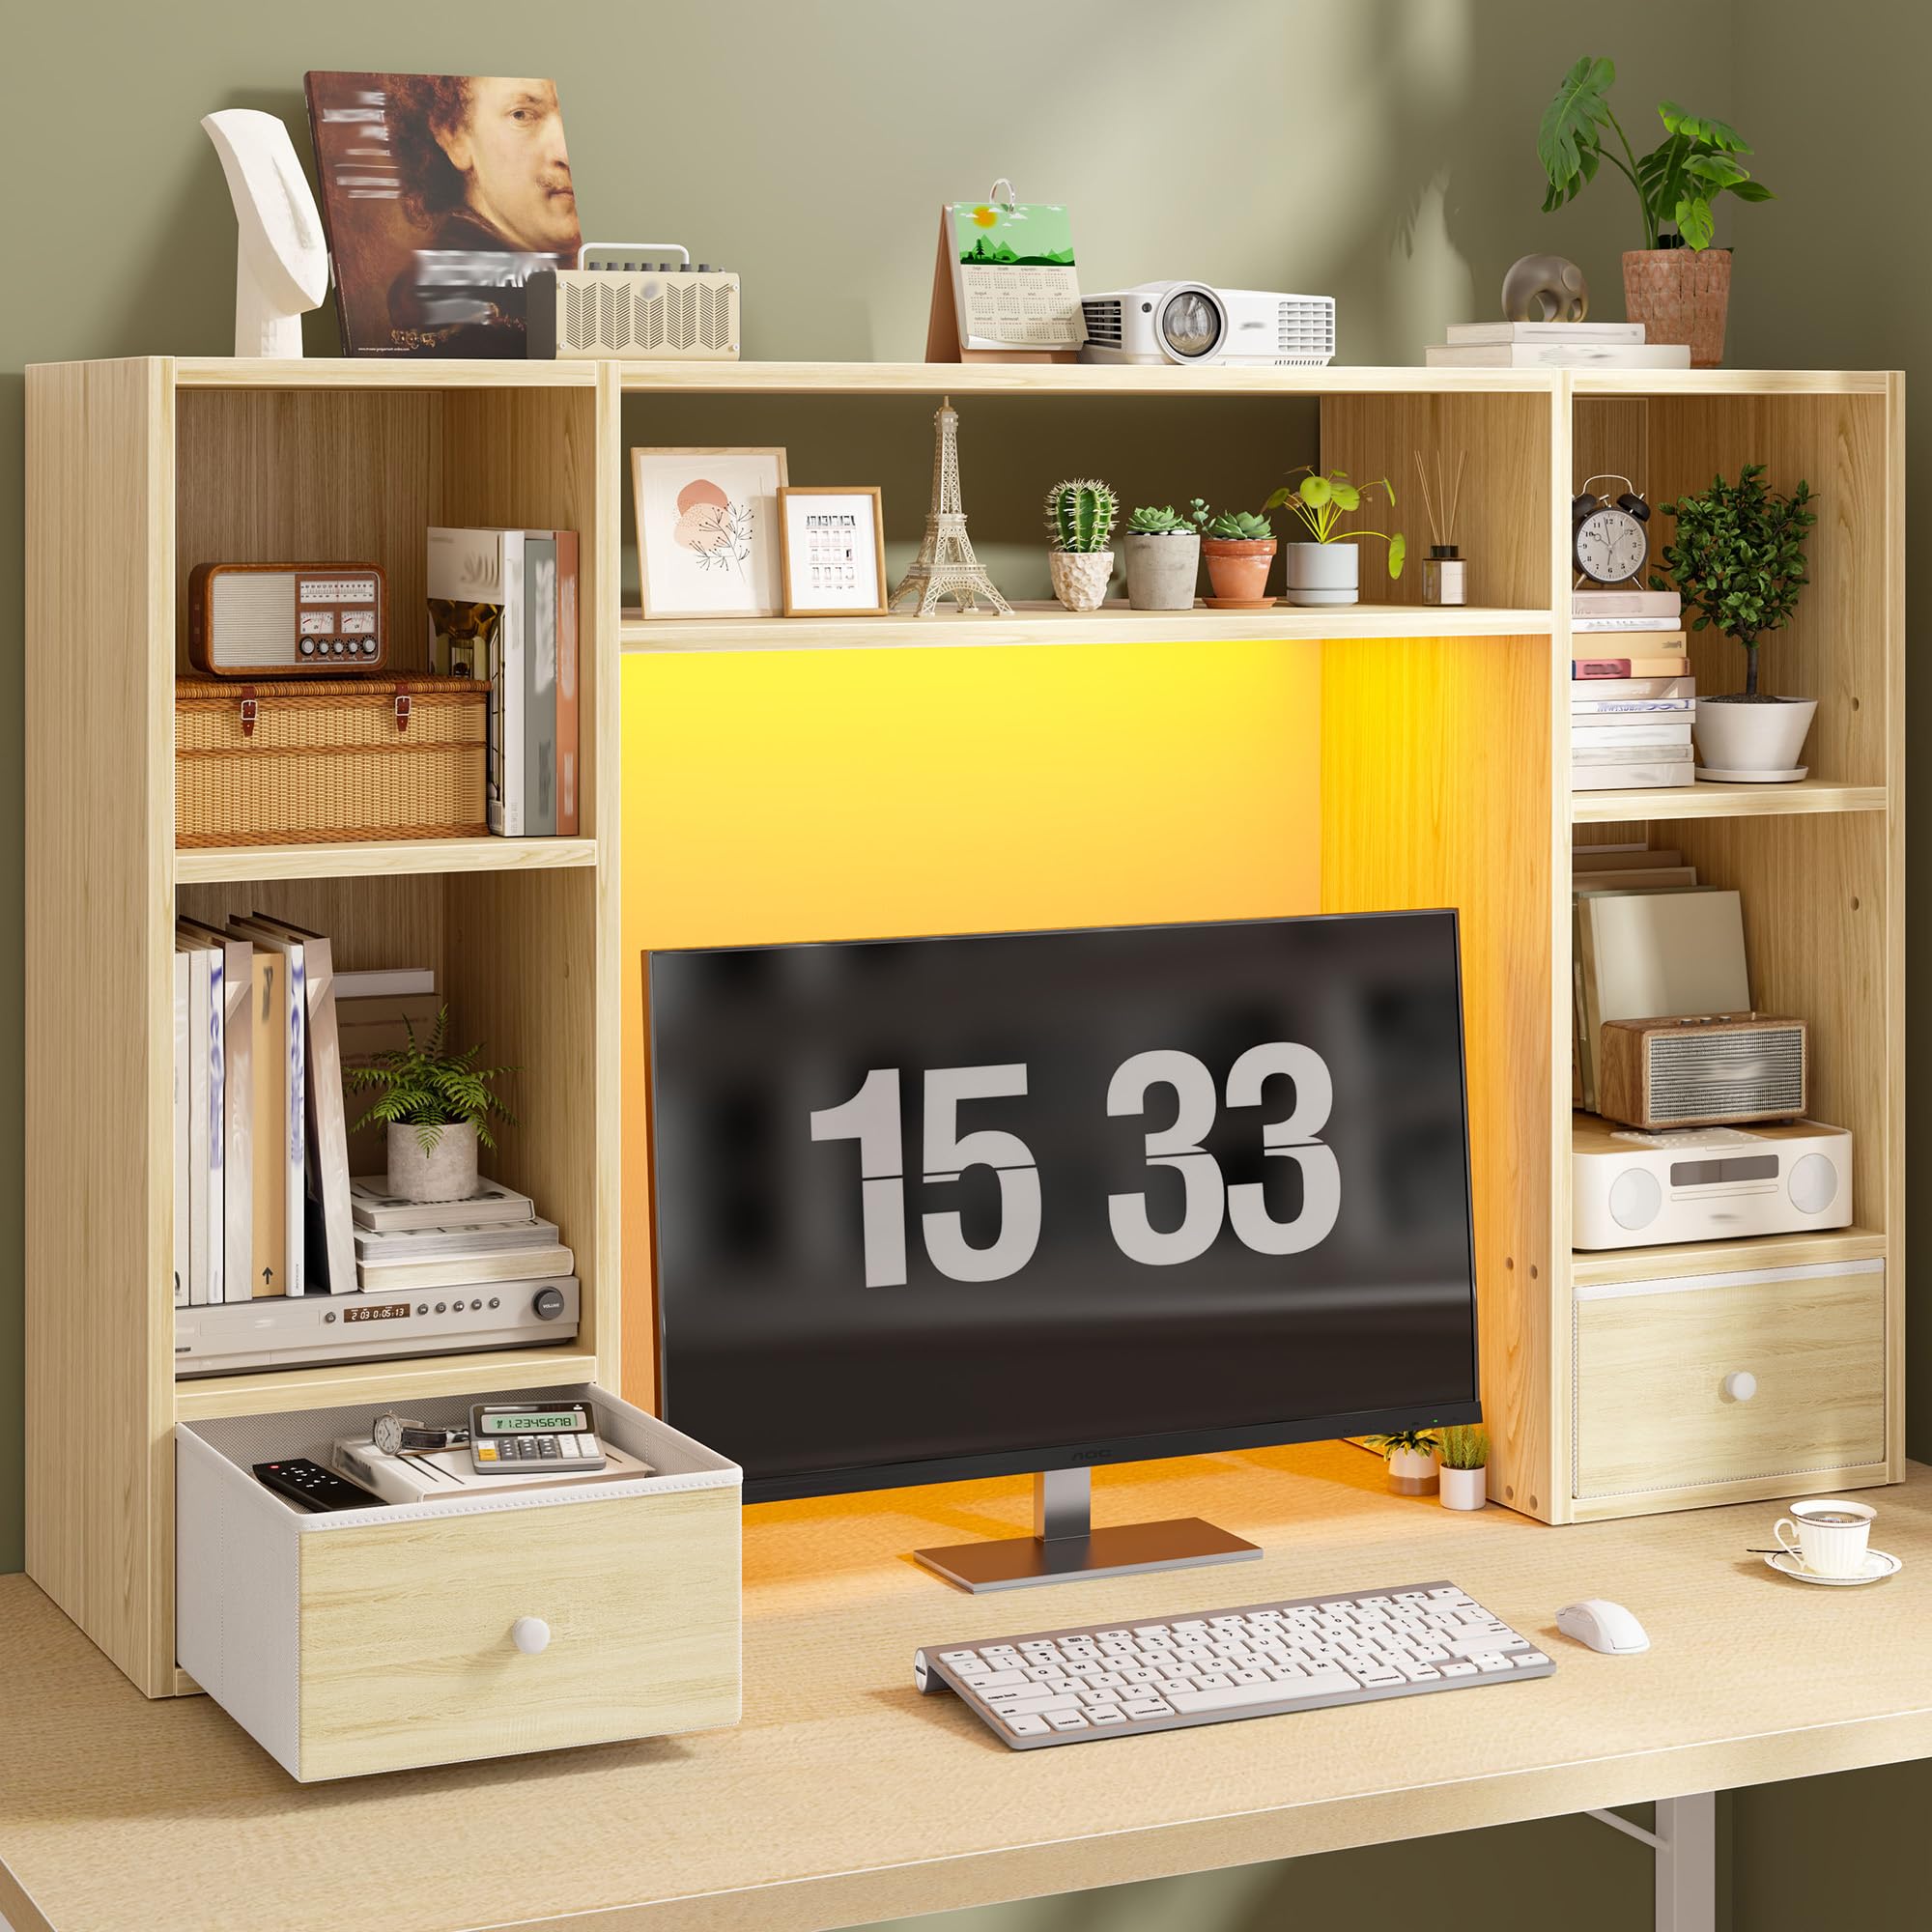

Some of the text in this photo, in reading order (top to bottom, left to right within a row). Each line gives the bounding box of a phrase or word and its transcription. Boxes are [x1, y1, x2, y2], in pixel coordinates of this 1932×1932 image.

[810, 1041, 1342, 1289] 15 33
[351, 1312, 357, 1321] 2
[359, 1311, 370, 1320] 03
[508, 1417, 572, 1429] 1.2345678
